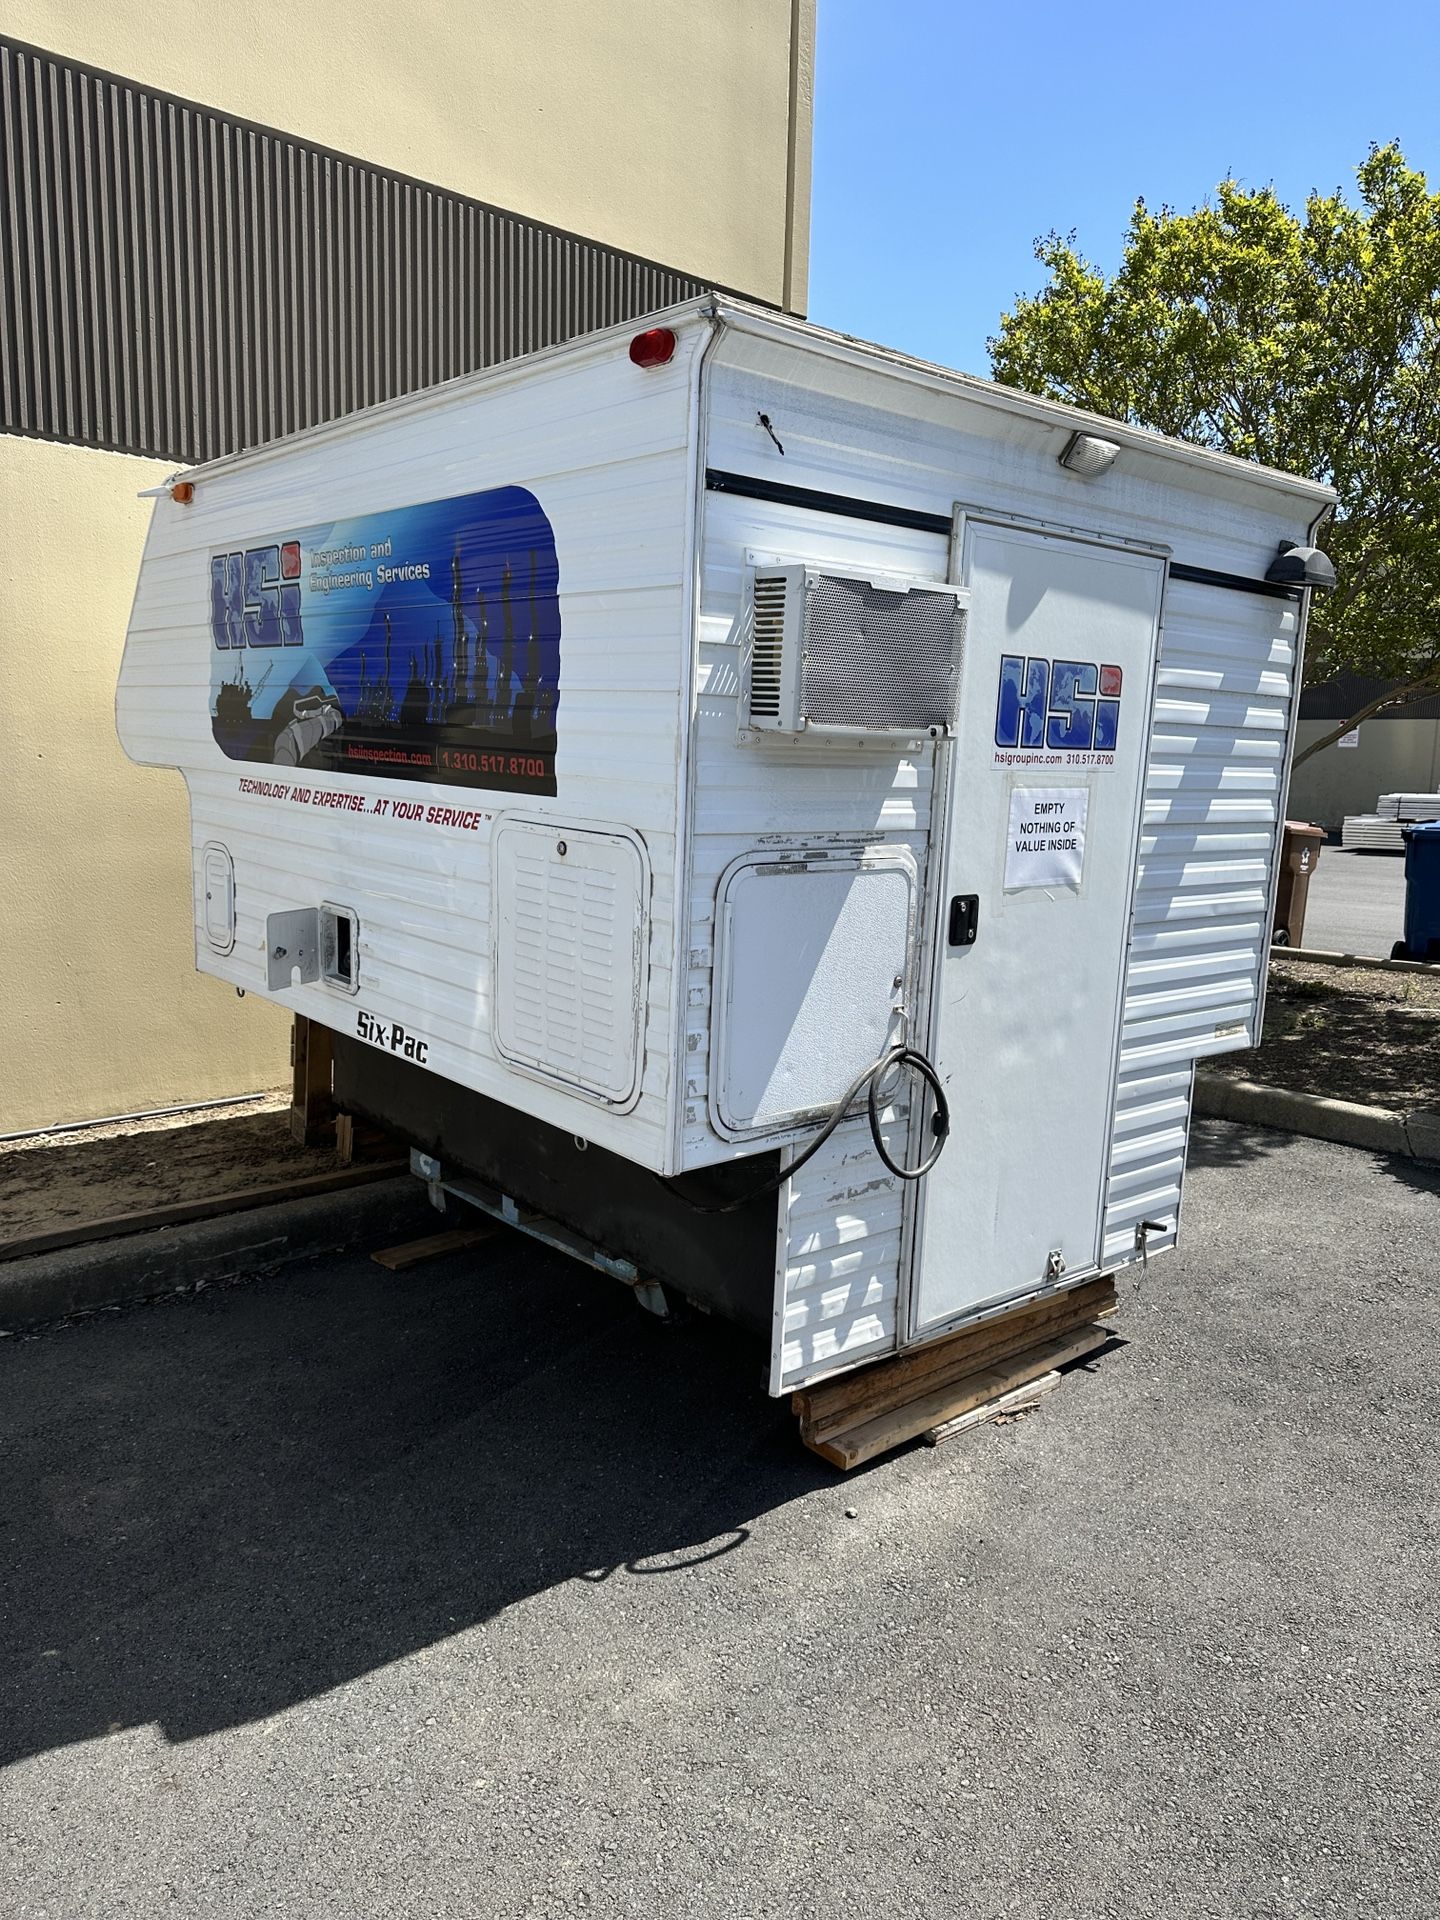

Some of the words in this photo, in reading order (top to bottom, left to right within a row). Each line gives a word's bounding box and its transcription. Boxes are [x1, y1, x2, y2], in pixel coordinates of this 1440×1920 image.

[310, 542, 366, 571] Inspection
[370, 536, 392, 558] and
[310, 567, 373, 595] Engineering
[376, 561, 430, 584] Services
[347, 744, 432, 766] hsiinspection.com
[442, 752, 545, 777] 1.310.517.8700
[994, 752, 1062, 766] hsigroupinc.com
[1066, 754, 1114, 765] 310.517.8700
[238, 778, 291, 799] TECHNOLOGY
[290, 789, 311, 804] AND
[392, 801, 424, 822] YOUR
[426, 806, 482, 831] SERVICE
[1034, 803, 1065, 815] EMPTY
[1020, 822, 1061, 834] NOTHING
[1063, 821, 1076, 833] OF
[1015, 840, 1046, 852] VALUE
[1048, 838, 1077, 851] INSIDE
